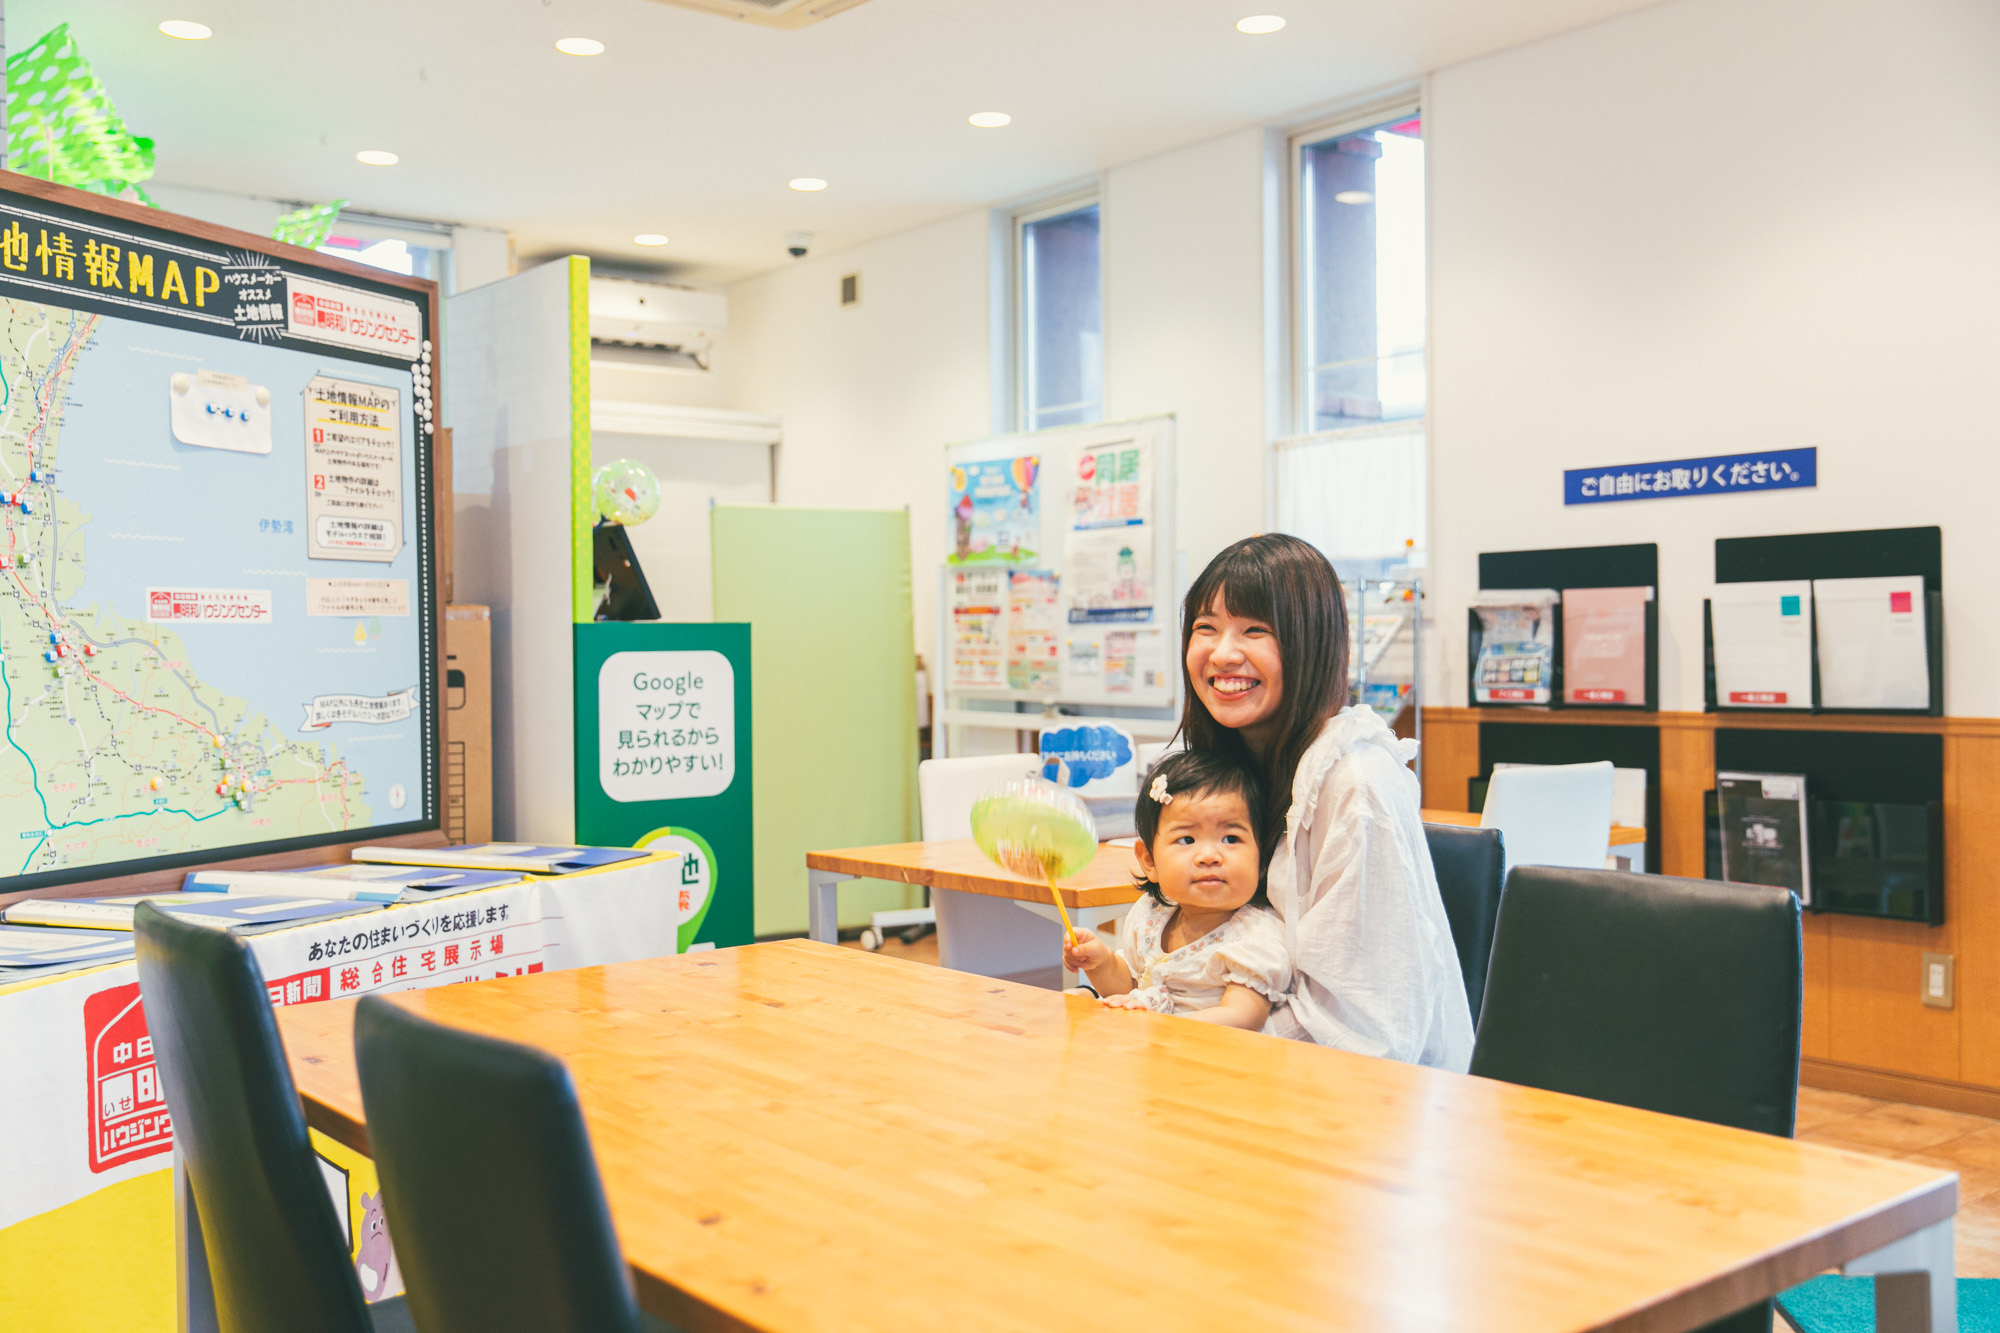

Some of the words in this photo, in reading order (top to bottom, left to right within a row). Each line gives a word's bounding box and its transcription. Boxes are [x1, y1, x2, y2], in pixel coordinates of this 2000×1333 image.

[224, 272, 282, 286] ハウスメーカー
[238, 288, 272, 301] オススメ
[233, 303, 284, 321] 土地情報
[316, 388, 390, 410] 土地情報MAPの
[329, 409, 379, 427] ご利用方法
[1581, 461, 1800, 497] ご自由にお取りください。
[633, 671, 704, 696] Google
[636, 701, 702, 721] マップで
[617, 727, 720, 750] 見られるから
[612, 753, 724, 777] わかりやすい!
[307, 904, 509, 962] あなたの住まいづくりを応援します。
[340, 934, 504, 992] 総合住宅展示場
